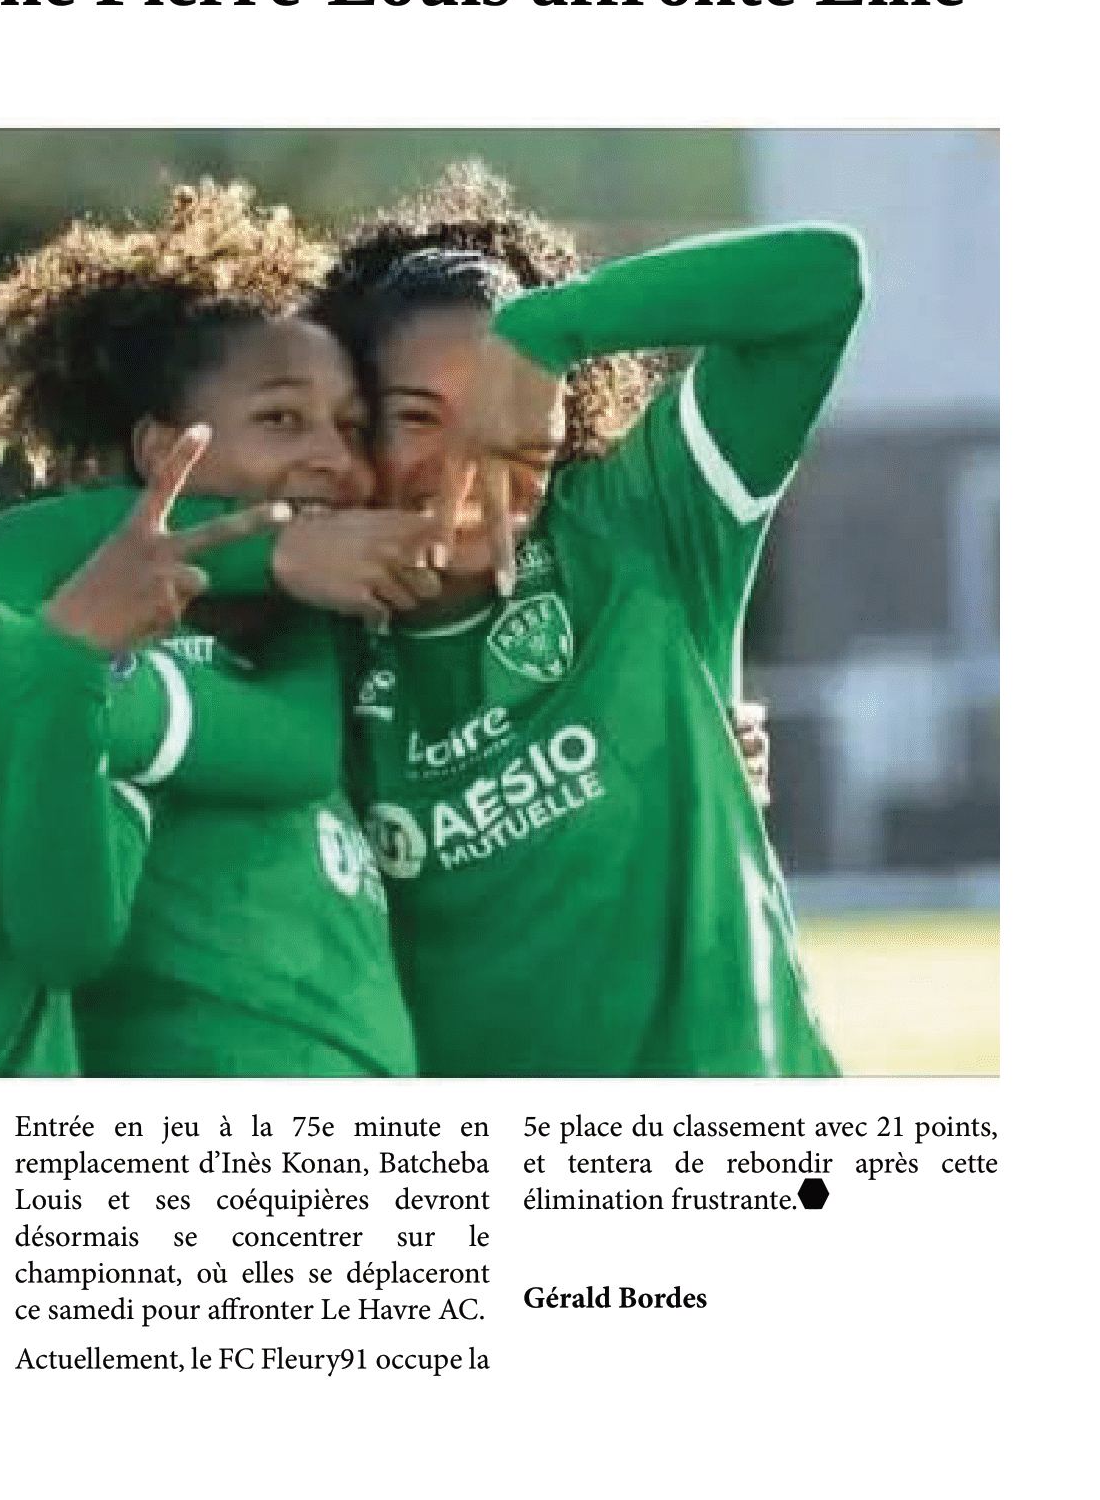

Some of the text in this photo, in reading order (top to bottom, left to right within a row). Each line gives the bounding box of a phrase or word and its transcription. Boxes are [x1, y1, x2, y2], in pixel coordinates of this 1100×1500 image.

[438, 770, 607, 871] MUTUELLE
[15, 1150, 490, 1181] remplacement d’Inès Konan, Batcheba
[523, 1186, 797, 1211] élimination frustrante.
[15, 1260, 490, 1291] championnat, où elles se déplaceront
[523, 1285, 708, 1309] Gérald Bordes
